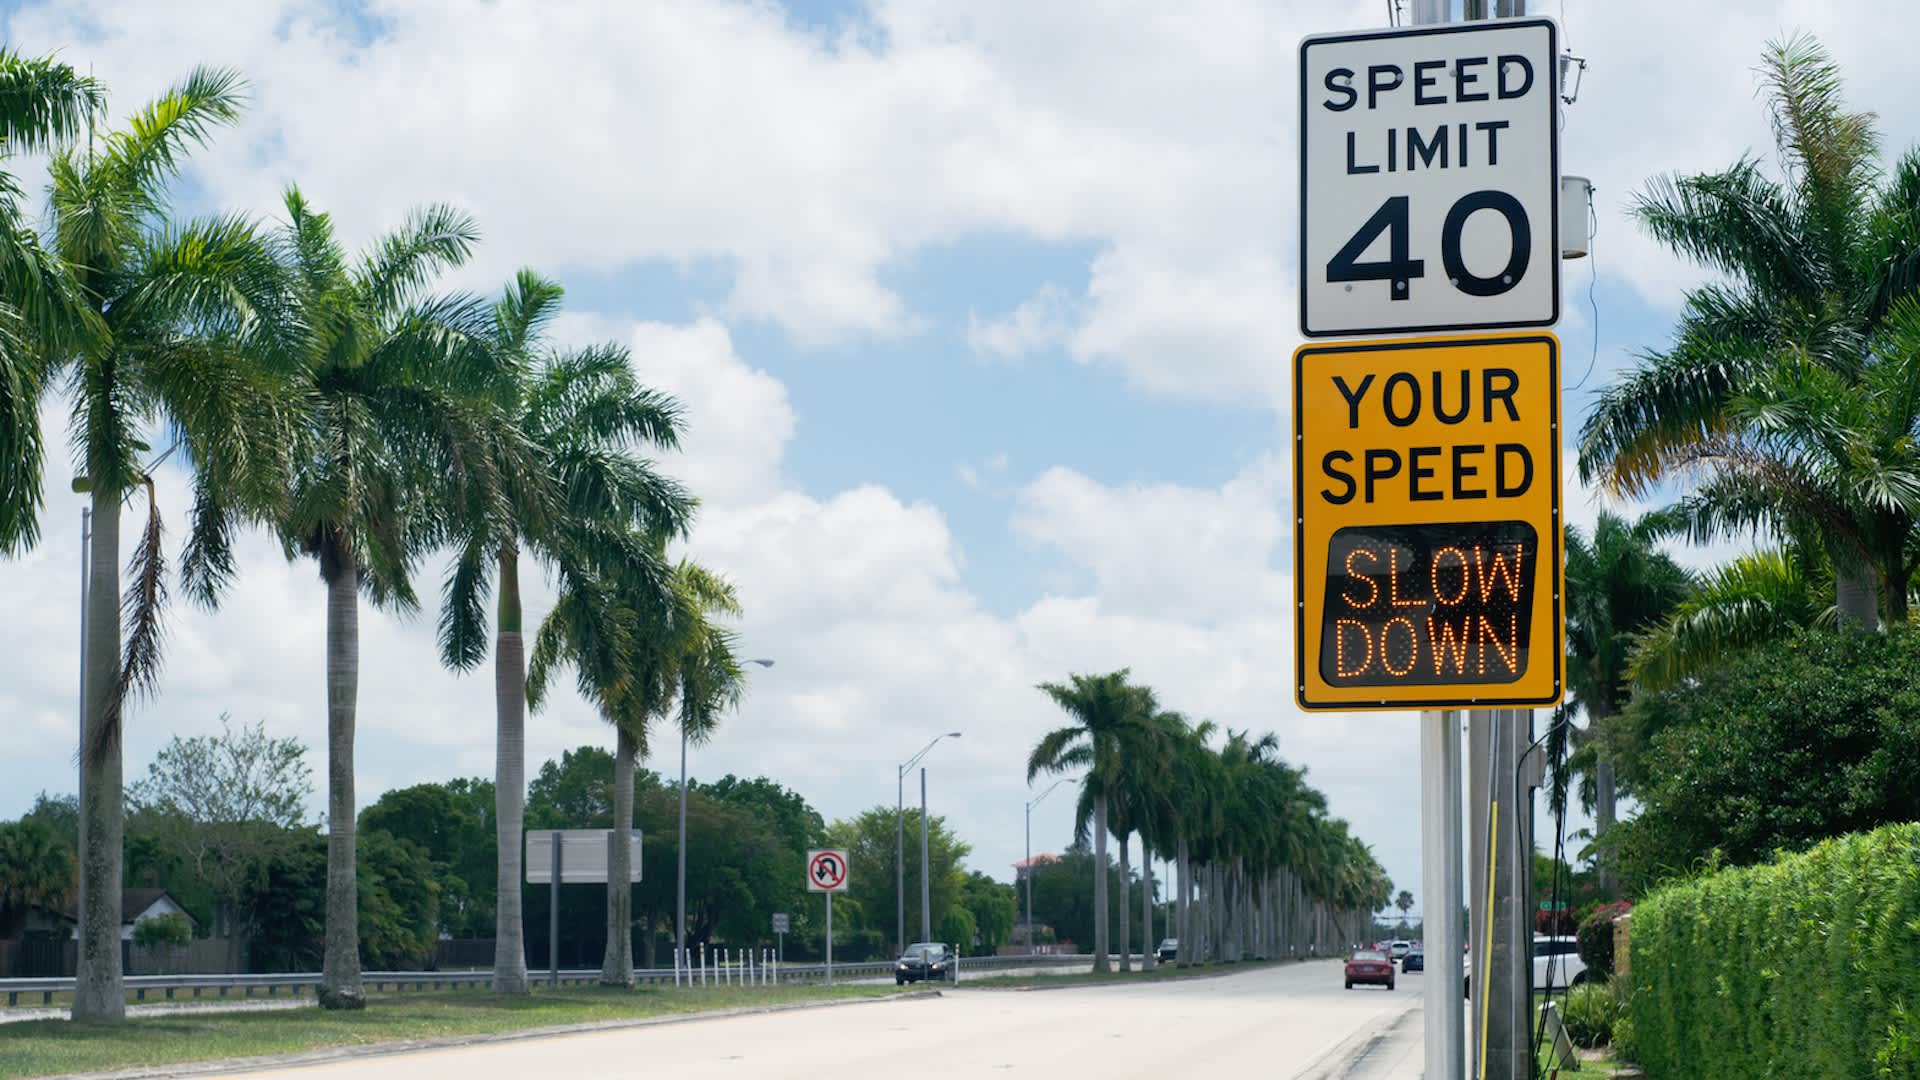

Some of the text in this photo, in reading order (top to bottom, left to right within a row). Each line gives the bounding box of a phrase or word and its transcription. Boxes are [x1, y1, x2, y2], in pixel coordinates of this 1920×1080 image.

[1322, 54, 1534, 112] SPEED
[1347, 120, 1509, 175] LIMIT
[1326, 190, 1531, 301] 40
[1331, 368, 1521, 429] YOUR
[1320, 443, 1534, 505] SPEED
[1341, 543, 1523, 609] SLOW
[1336, 613, 1517, 678] DOWN
